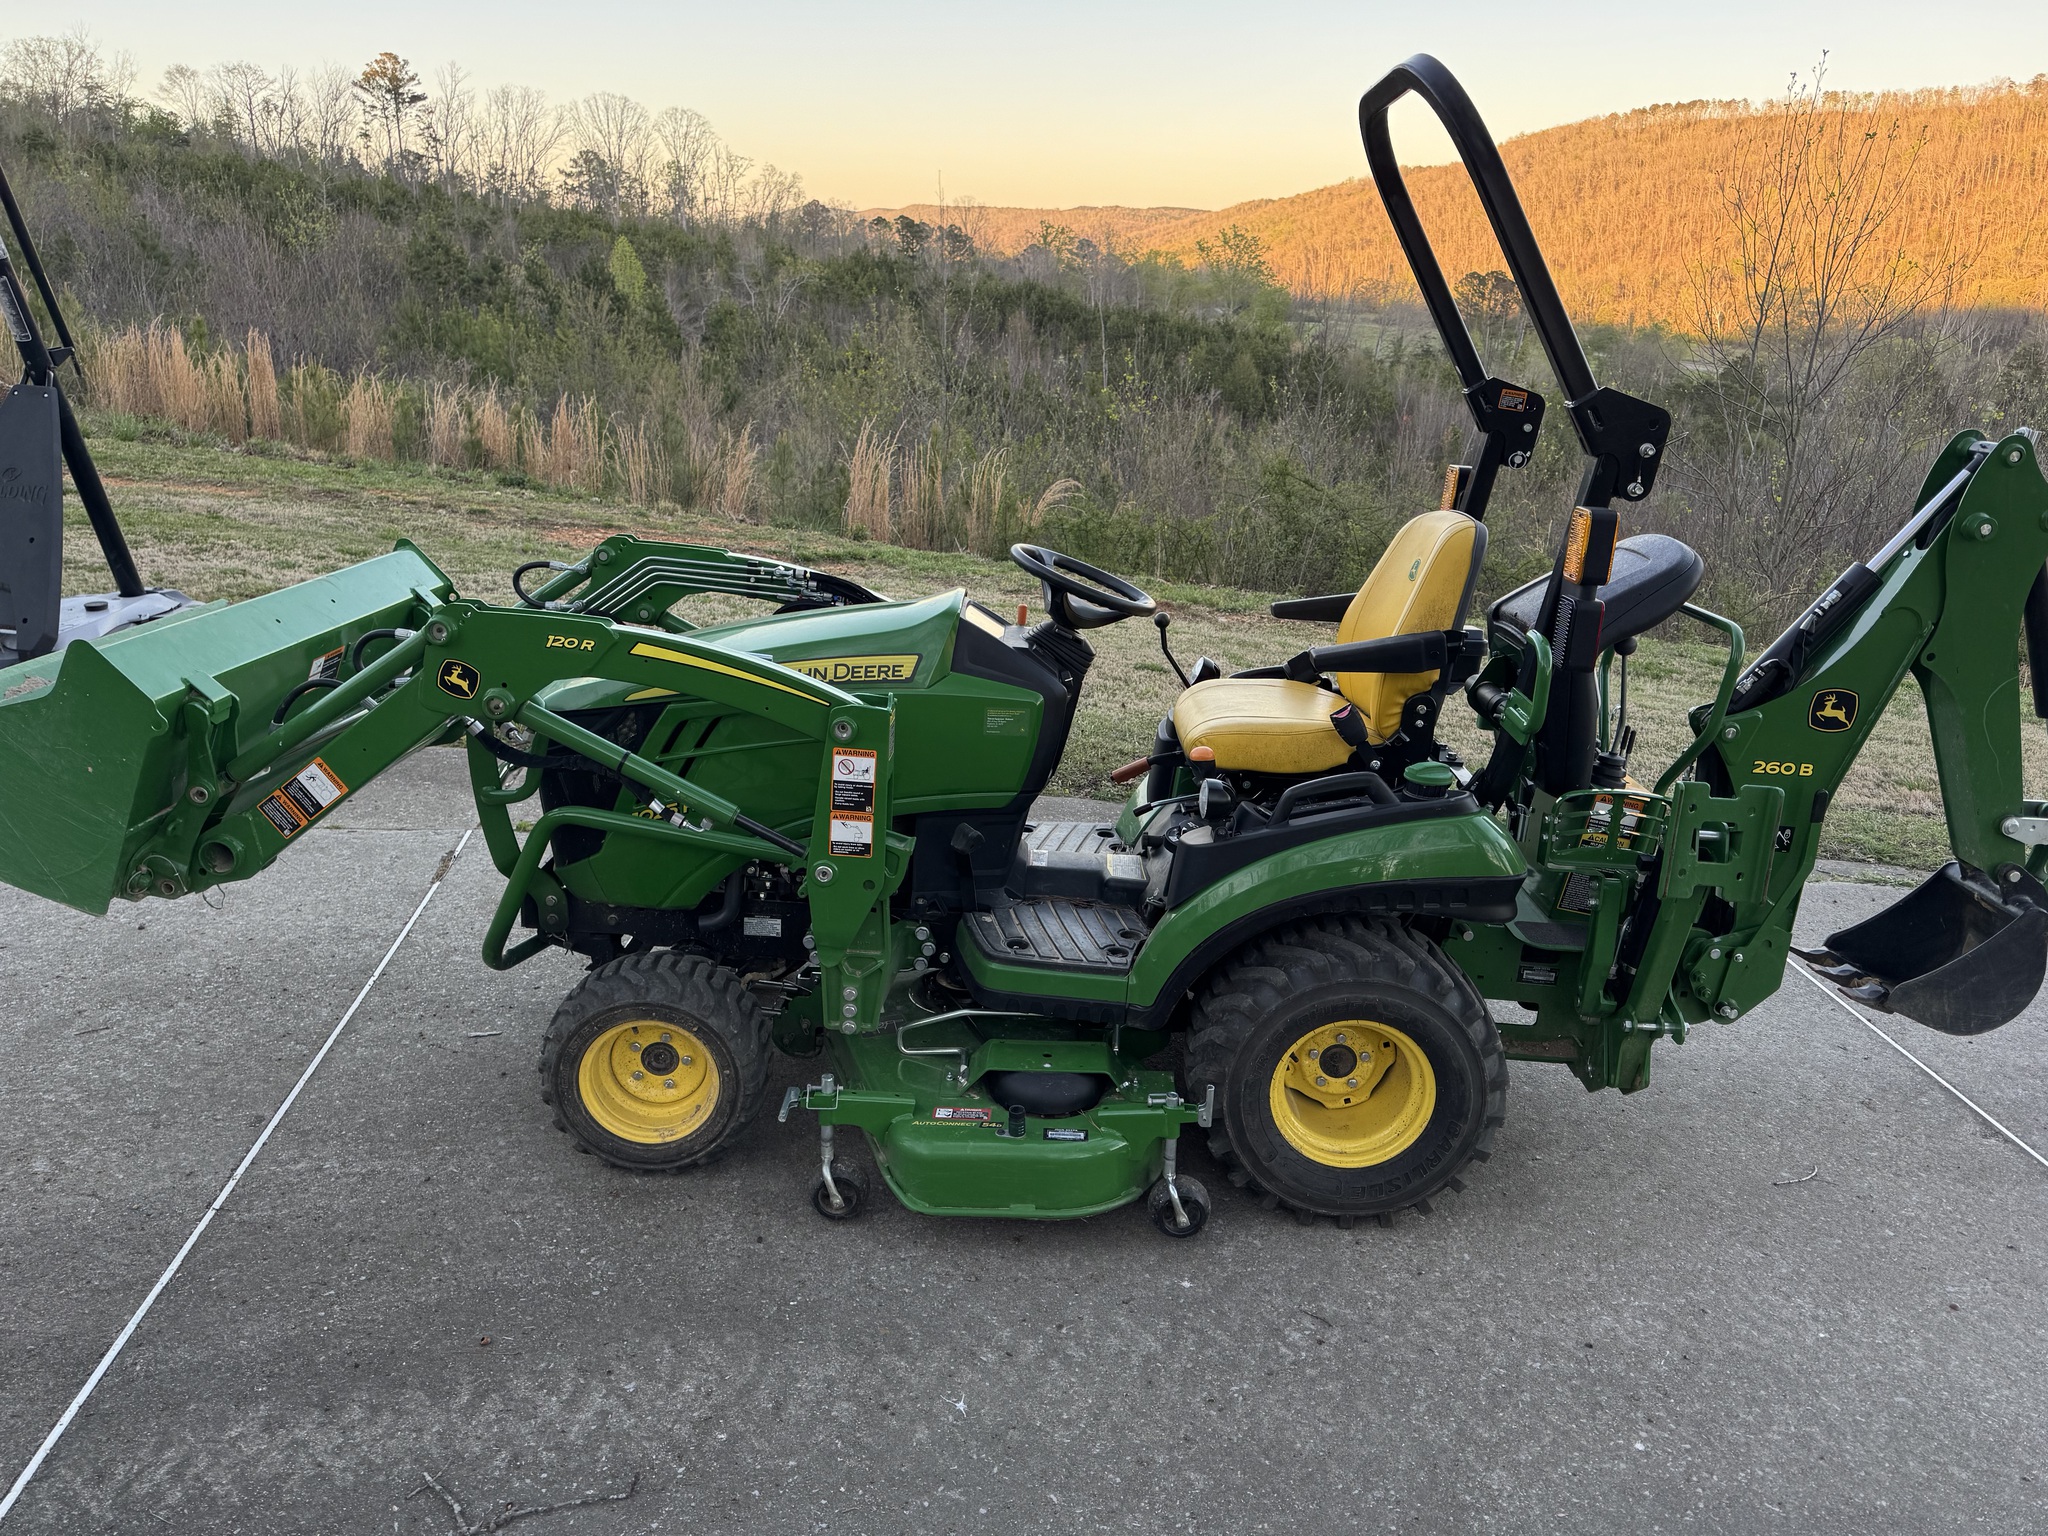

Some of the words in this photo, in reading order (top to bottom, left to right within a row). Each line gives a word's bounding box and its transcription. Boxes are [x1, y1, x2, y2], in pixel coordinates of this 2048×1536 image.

[545, 634, 579, 649] 120
[579, 639, 595, 651] R
[797, 666, 829, 682] HN
[833, 663, 905, 680] DEERE
[842, 749, 875, 758] WARNING
[1752, 760, 1797, 775] 260
[1798, 763, 1814, 776] B
[323, 766, 344, 790] WARNING
[282, 799, 303, 823] WARNING
[1607, 797, 1639, 809] WNING
[839, 813, 872, 822] WARNING
[1350, 1120, 1464, 1200] CARLISLE
